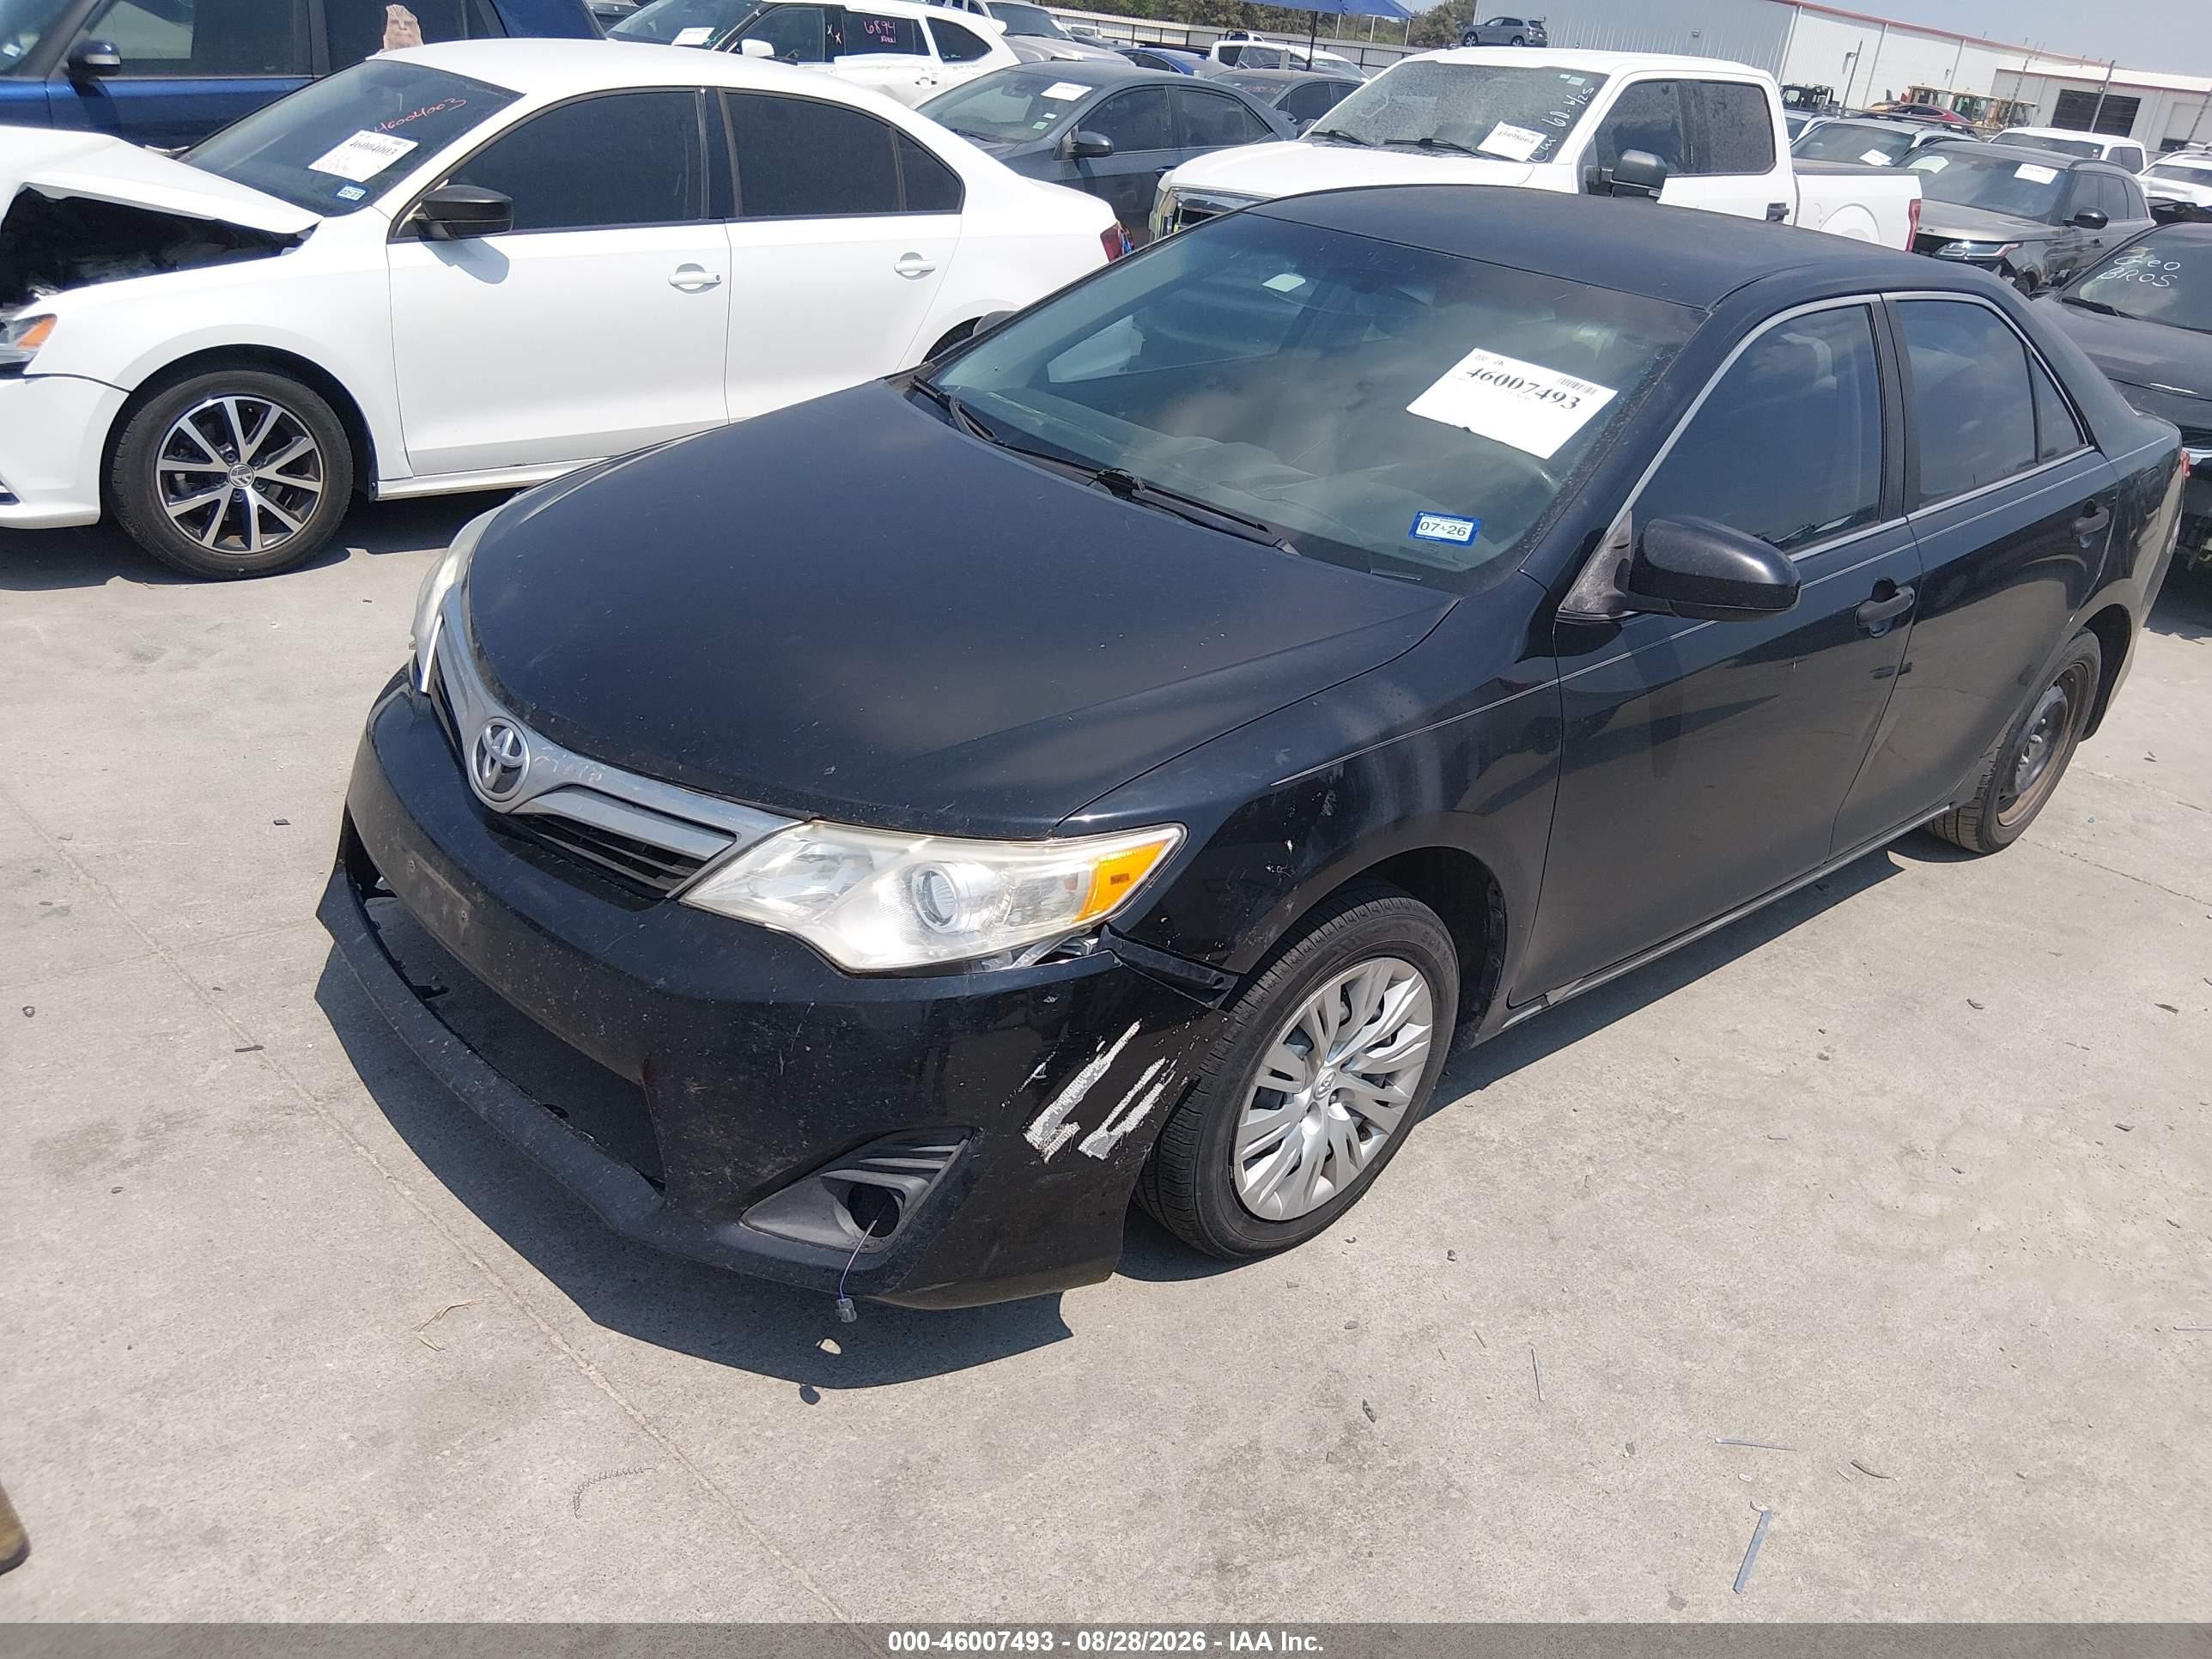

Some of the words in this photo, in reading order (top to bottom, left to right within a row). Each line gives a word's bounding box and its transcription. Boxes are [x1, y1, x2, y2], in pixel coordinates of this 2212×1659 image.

[863, 20, 896, 35] 6894
[374, 97, 467, 132] 46004003
[1466, 367, 1582, 410] 46007493
